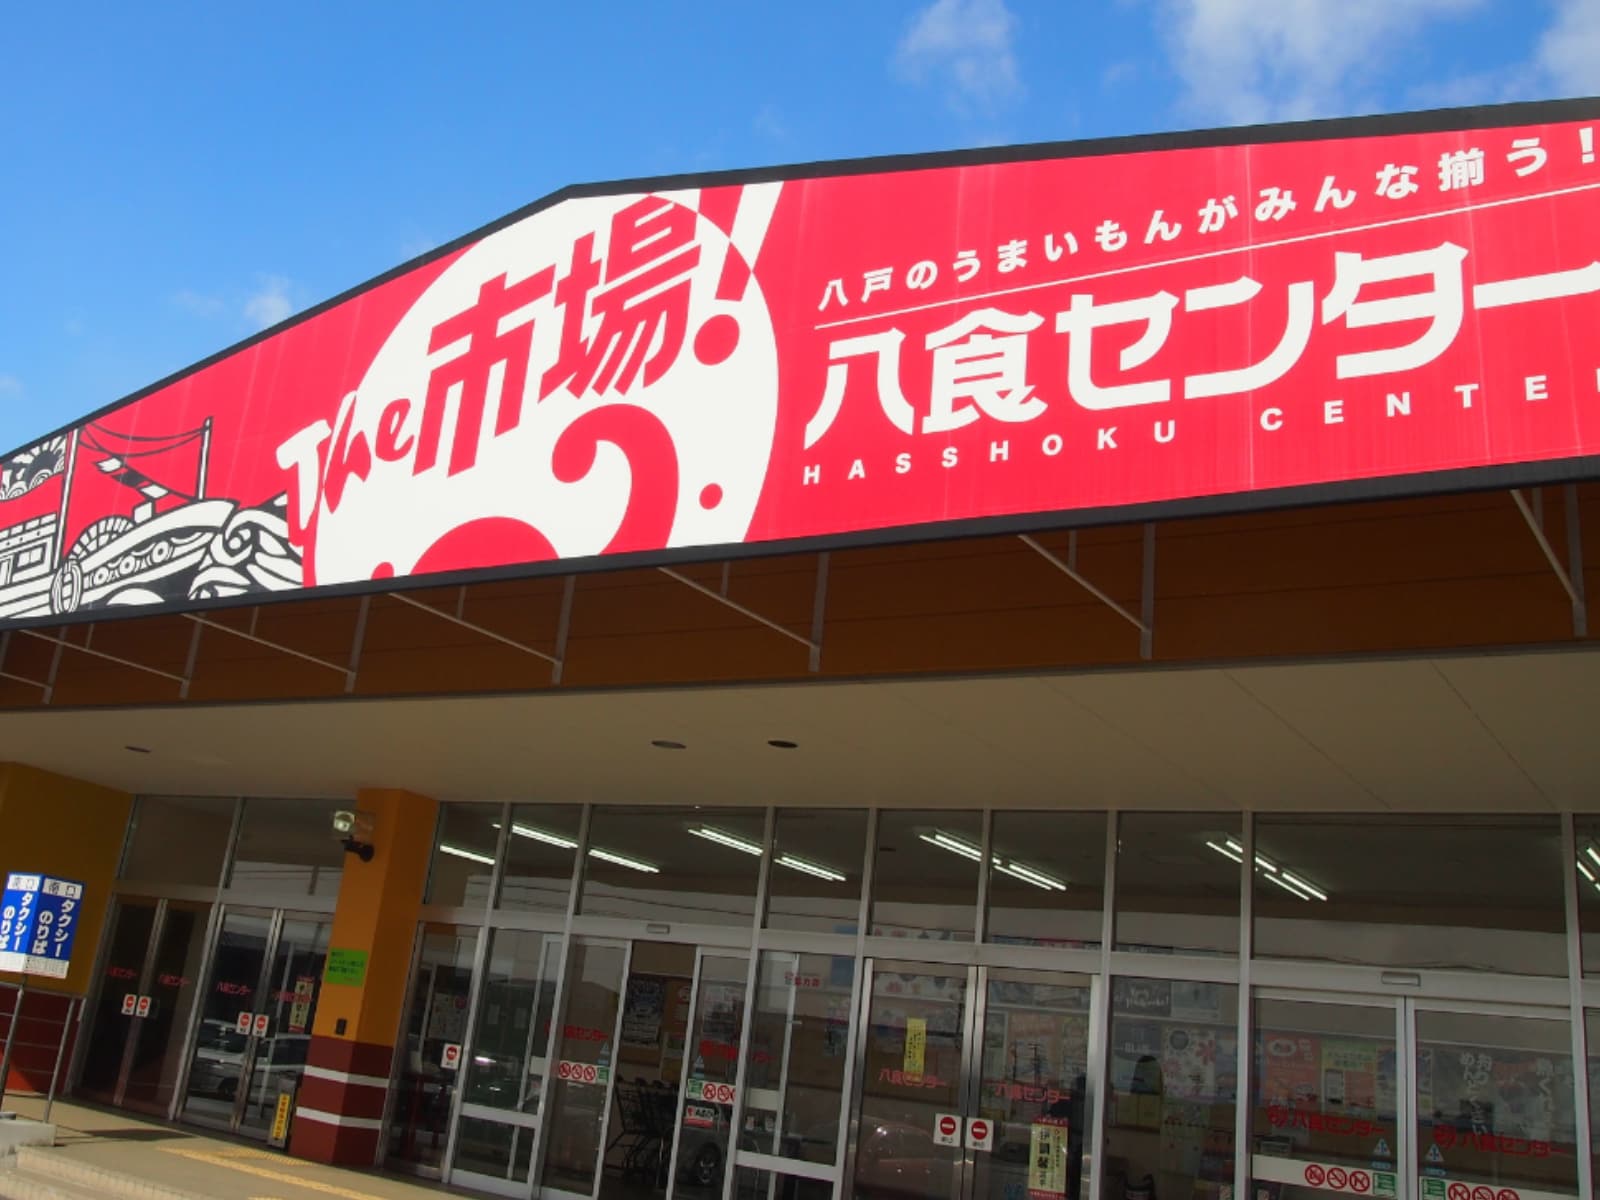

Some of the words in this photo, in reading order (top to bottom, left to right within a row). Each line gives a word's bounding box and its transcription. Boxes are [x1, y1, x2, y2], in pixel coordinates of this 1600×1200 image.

[803, 241, 1600, 450] 八食センター
[275, 389, 415, 531] The
[802, 419, 1177, 485] HASSHOKU
[1259, 367, 1600, 431] CENTE
[13, 891, 34, 951] タクシー
[31, 910, 54, 955] のりば
[54, 898, 76, 957] タクシー
